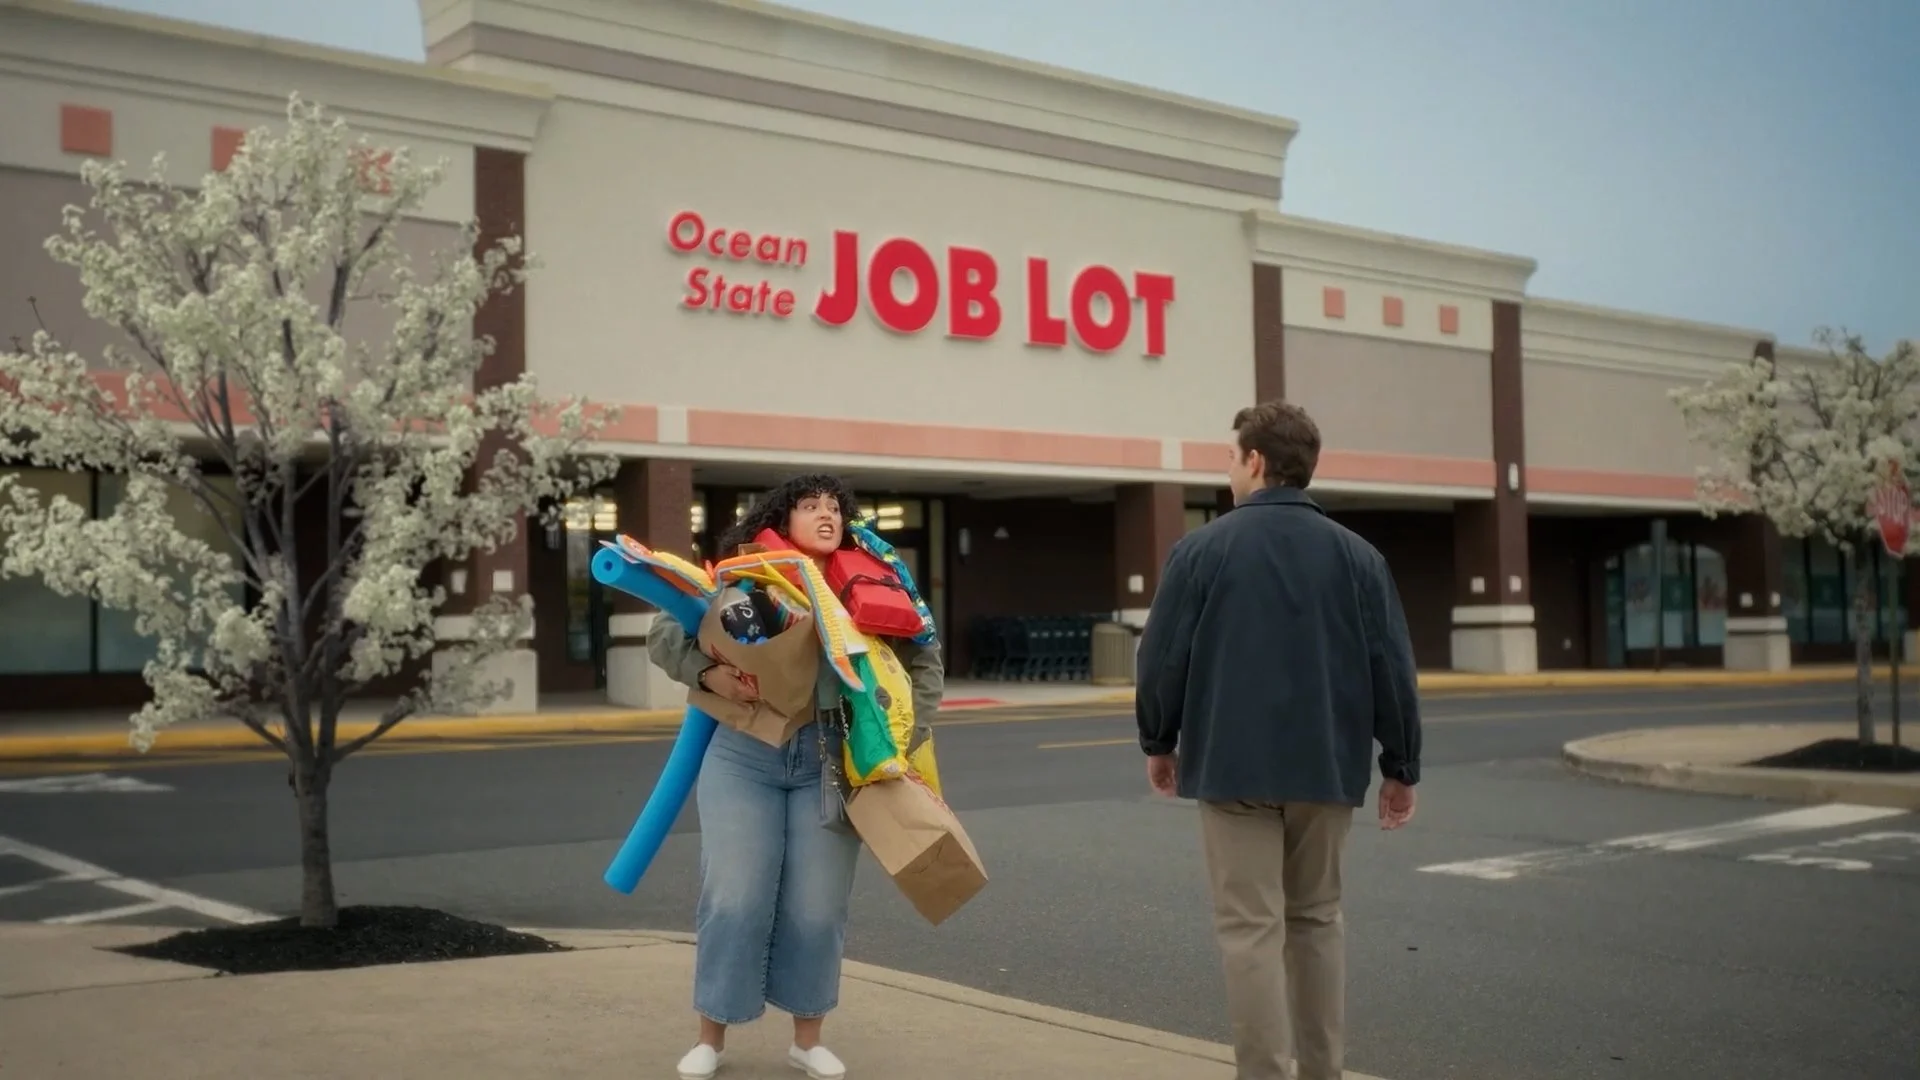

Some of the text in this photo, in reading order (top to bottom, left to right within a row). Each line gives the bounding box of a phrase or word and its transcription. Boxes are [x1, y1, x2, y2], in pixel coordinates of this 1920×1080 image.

[667, 211, 808, 265] Ocean
[685, 268, 797, 318] State
[815, 230, 1175, 357] JOB LOT
[1877, 486, 1908, 525] STOP
